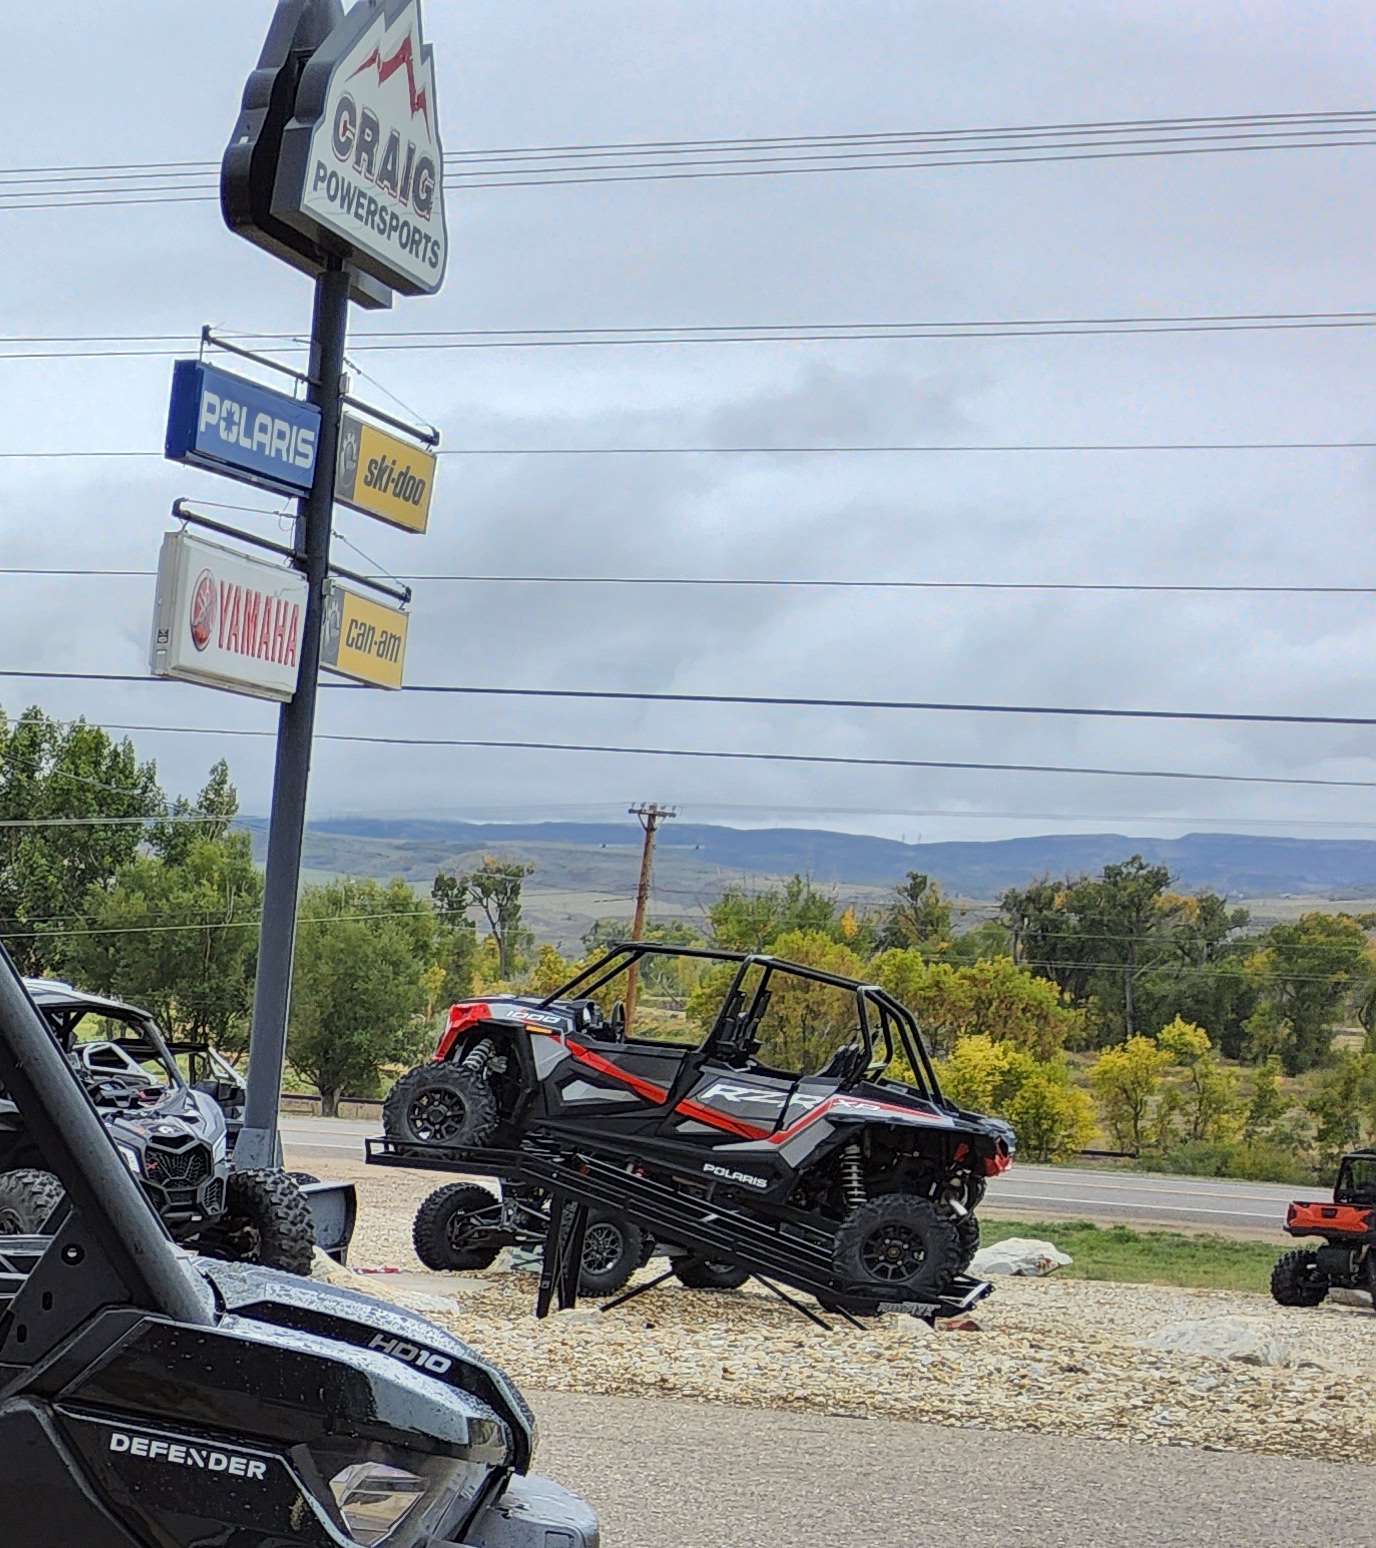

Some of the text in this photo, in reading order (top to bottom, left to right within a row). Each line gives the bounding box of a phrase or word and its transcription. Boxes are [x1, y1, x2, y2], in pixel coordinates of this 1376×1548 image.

[332, 91, 436, 221] CRAIG
[312, 160, 441, 269] POWERSPORTS
[200, 390, 315, 470] POLARIS
[363, 455, 426, 507] ski-doo
[218, 580, 300, 668] YAMAHA
[345, 618, 402, 664] can-am
[506, 1010, 561, 1024] 1000
[701, 1083, 829, 1110] RZR
[832, 1099, 881, 1111] XP
[702, 1163, 768, 1188] POLARIS
[367, 1333, 453, 1375] HD10
[110, 1433, 267, 1480] DEFENDER
